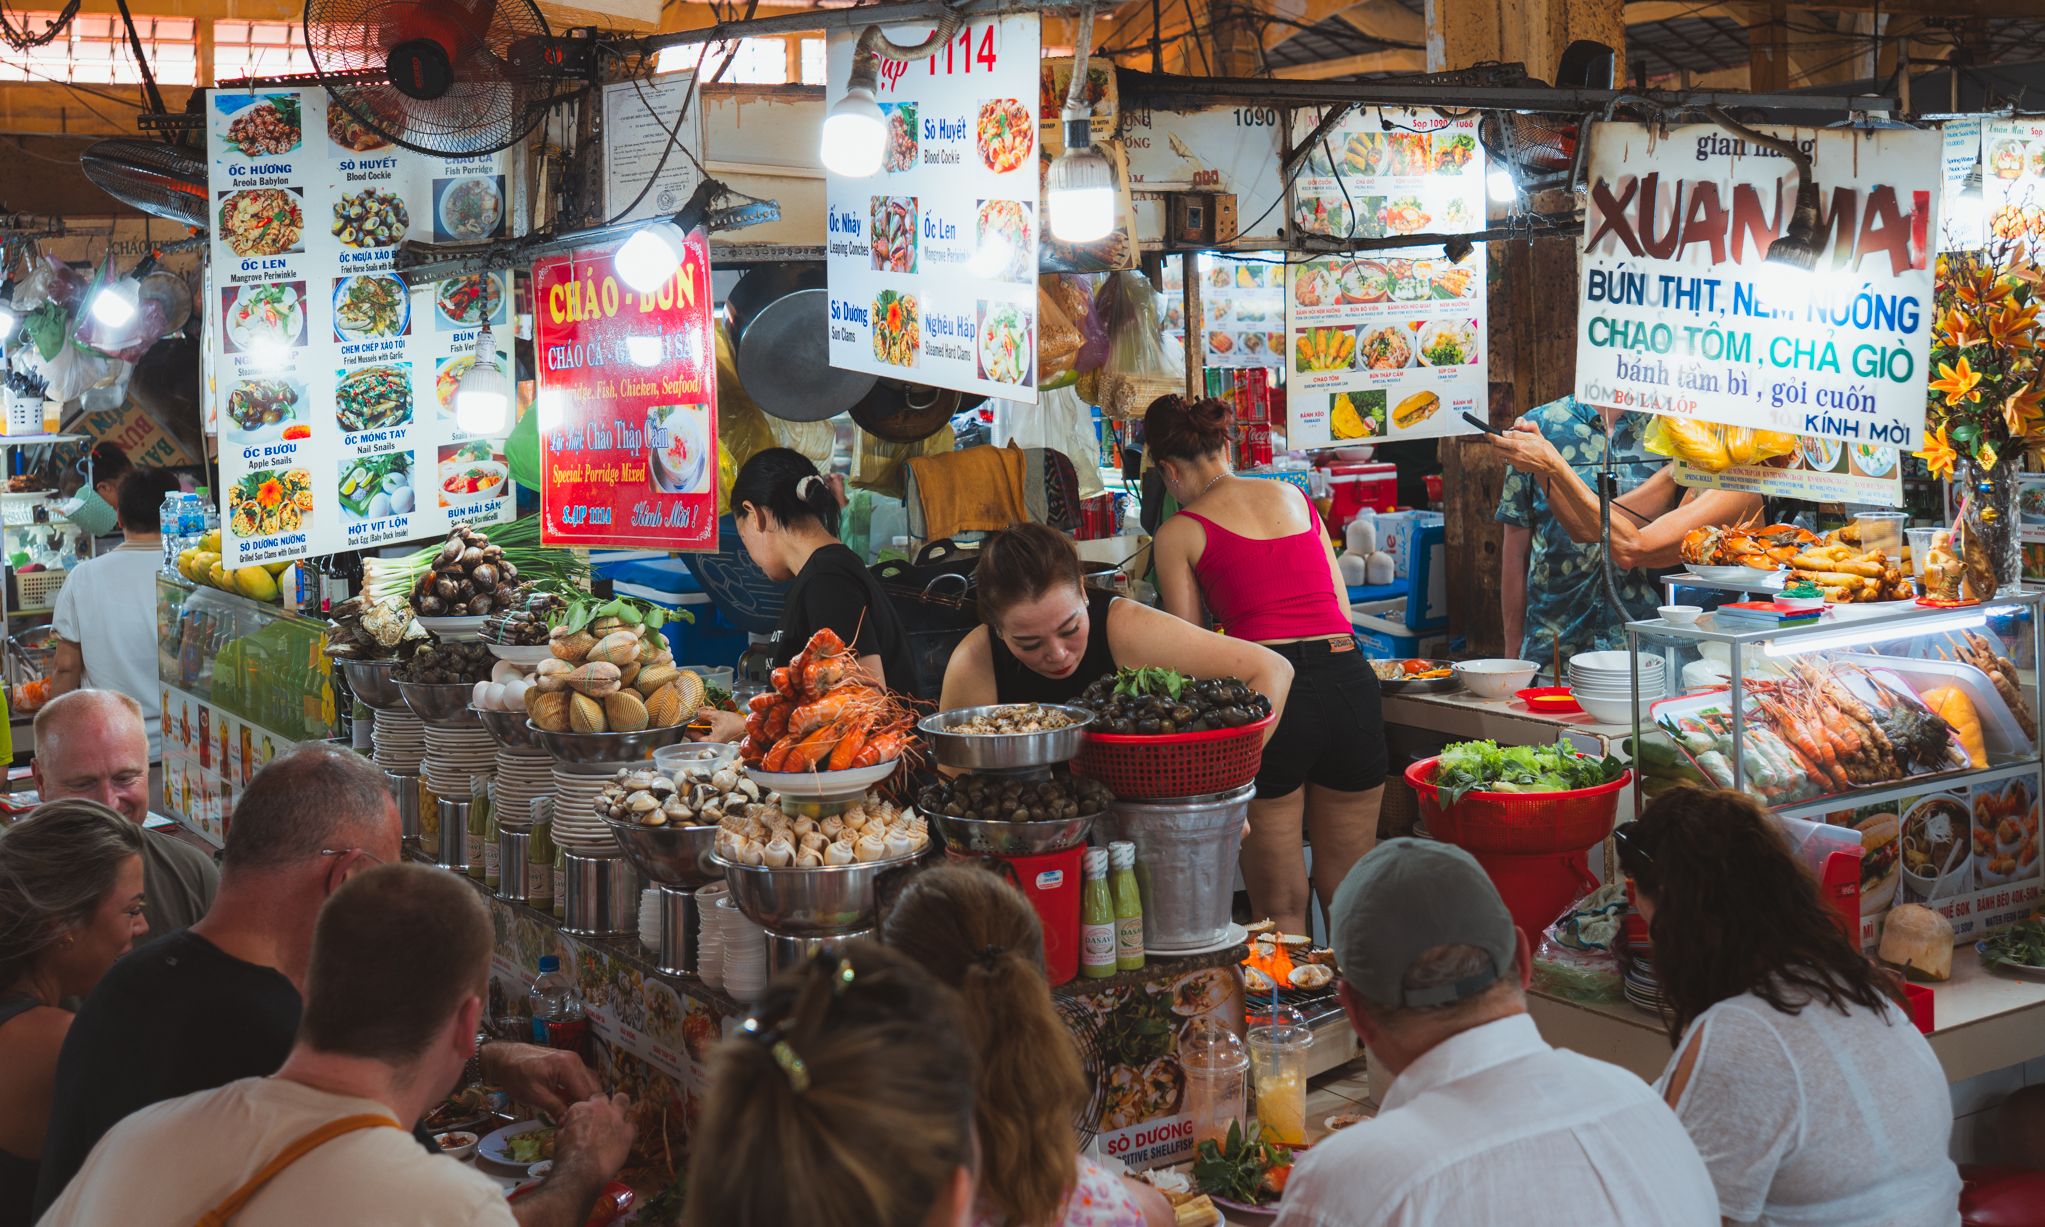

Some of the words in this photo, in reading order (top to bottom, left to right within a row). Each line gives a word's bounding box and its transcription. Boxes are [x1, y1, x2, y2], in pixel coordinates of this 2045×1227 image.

[929, 25, 996, 75] 1114
[1234, 109, 1275, 126] 1090
[924, 117, 936, 140] Sò
[940, 116, 967, 143] Huyết
[1697, 134, 1747, 161] gian
[340, 158, 357, 171] SÒ
[360, 157, 397, 169] HUYẾT
[924, 150, 940, 164] Blood
[941, 150, 960, 164] Cockie
[228, 165, 249, 177] ỐC
[250, 164, 292, 175] HƯƠNG
[346, 172, 365, 181] Blood
[368, 170, 391, 180] Cockie
[445, 167, 460, 175] Fish
[463, 165, 493, 175] Porridge
[233, 177, 256, 187] Areola
[259, 176, 288, 186] Babylon
[830, 205, 840, 232] Ốc
[842, 211, 861, 236] Nhảy
[924, 210, 936, 239] Ốc
[939, 223, 956, 240] Len
[340, 251, 350, 262] ỐC
[352, 252, 372, 263] NGỰA
[375, 249, 389, 260] XÀO
[830, 241, 848, 256] Leaping
[849, 242, 869, 256] Conches
[924, 247, 946, 263] Mangrove
[241, 258, 260, 270] ỐC
[262, 259, 286, 269] LEN
[341, 264, 352, 274] Fried
[353, 264, 366, 272] Horse
[366, 262, 378, 271] Snails
[379, 262, 388, 270] with
[230, 272, 261, 283] Mangrove
[262, 270, 297, 281] Periwinkle
[549, 266, 619, 325] CHÁO
[1588, 262, 1645, 307] BÚN
[1659, 275, 1727, 320] THỊT,
[831, 299, 841, 320] Sò
[844, 301, 868, 327] Dương
[832, 326, 840, 340] Sun
[842, 328, 855, 342] Clams
[925, 314, 953, 337] Nghêu
[957, 312, 975, 340] Hấp
[453, 332, 474, 342] BÚN
[341, 343, 360, 354] CHEM
[362, 341, 378, 352] CHÉP
[379, 341, 393, 351] XÀO
[394, 340, 406, 350] TỎI
[451, 344, 462, 352] Fish
[548, 339, 583, 371] CHÁO
[586, 337, 603, 367] CÁ
[925, 341, 944, 357] Steamed
[945, 343, 956, 360] Hard
[957, 346, 971, 361] Clams
[1588, 316, 1673, 356] CHẠO
[1769, 328, 1841, 374] CHẢ
[1852, 338, 1914, 383] GIÒ
[343, 356, 357, 365] Fried
[358, 354, 378, 364] Mussels
[379, 353, 389, 362] with
[390, 352, 403, 361] Garlic
[597, 385, 618, 401] Fish,
[620, 378, 660, 398] Chicken,
[662, 375, 702, 398] Seafood)
[1616, 354, 1670, 387] bánh
[1771, 381, 1807, 407] gỏi
[1816, 385, 1877, 414] cuốn
[587, 420, 612, 450] Cháo
[615, 419, 642, 456] Thập
[644, 412, 669, 450] Cẩm
[1805, 412, 1861, 439] KÍNH
[1870, 421, 1911, 446] MỜI
[344, 434, 358, 445] ỐC
[360, 431, 387, 445] MÓNG
[388, 430, 406, 441] TAY
[243, 445, 261, 459] ỐC
[357, 444, 372, 454] Nail
[374, 442, 395, 452] Snails
[249, 458, 269, 469] Apple
[271, 455, 292, 466] Snails
[553, 463, 583, 489] Special:
[584, 463, 619, 486] Porridge
[621, 463, 645, 483] Mixed
[448, 507, 466, 518] BÚN
[468, 502, 482, 514] HẢI
[590, 508, 611, 524] 1114
[632, 500, 661, 527] Kính
[348, 524, 366, 535] HỘT
[368, 522, 384, 535] VỊT
[386, 517, 408, 530] LỘN
[240, 540, 250, 552] SÒ
[253, 538, 278, 550] DƯƠNG
[281, 534, 306, 546] NƯỚNG
[348, 536, 359, 546] Duck
[360, 536, 368, 544] Egg
[240, 553, 254, 562] Grilled
[255, 552, 263, 560] Sun
[264, 550, 276, 559] Clams
[288, 547, 300, 556] Onion
[1956, 901, 1970, 917] 60K
[1977, 894, 1995, 913] BÁNH
[1985, 914, 2002, 927] WATER
[1863, 919, 1873, 939] MÌ
[1108, 1131, 1130, 1155] SÒ
[1136, 1120, 1193, 1149] DƯƠNG
[1150, 1138, 1194, 1160] SHELLFISH
